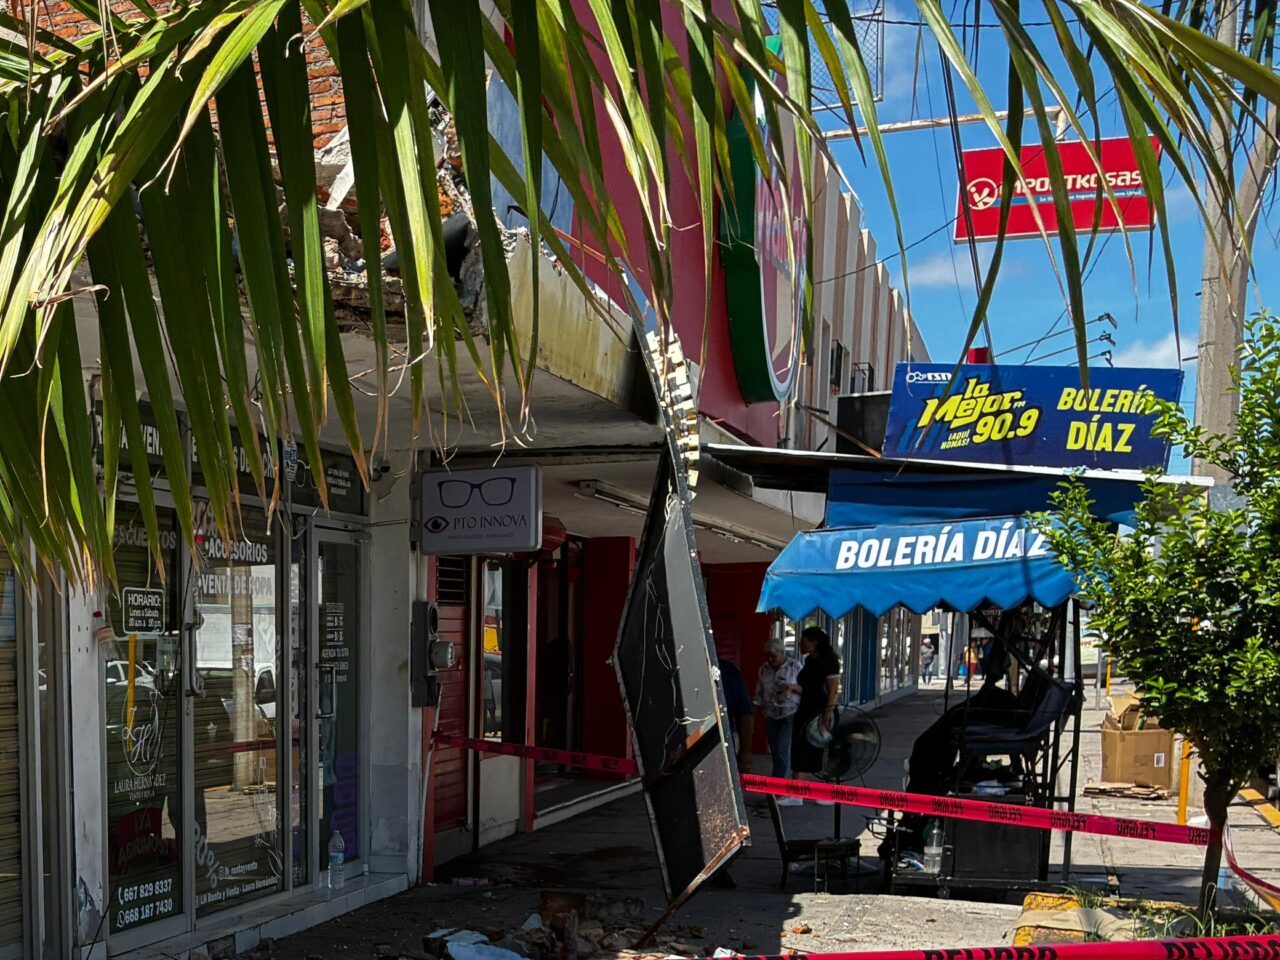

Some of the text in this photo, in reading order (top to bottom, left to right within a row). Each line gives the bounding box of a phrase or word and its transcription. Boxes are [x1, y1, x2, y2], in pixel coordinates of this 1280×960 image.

[964, 378, 990, 399] la
[917, 391, 1022, 429] Mejor
[972, 409, 1040, 444] 90.9
[1066, 414, 1136, 453] DÍAZ
[480, 514, 527, 528] INNOVA
[835, 522, 1052, 570] BOLERÍA DÍAZ
[202, 574, 232, 595] VENTA
[234, 575, 247, 595] DE
[128, 594, 162, 607] HORARIO:
[114, 778, 133, 794] LAURA
[123, 878, 172, 901] 667 829 8337
[125, 898, 173, 924] 668 187 7430
